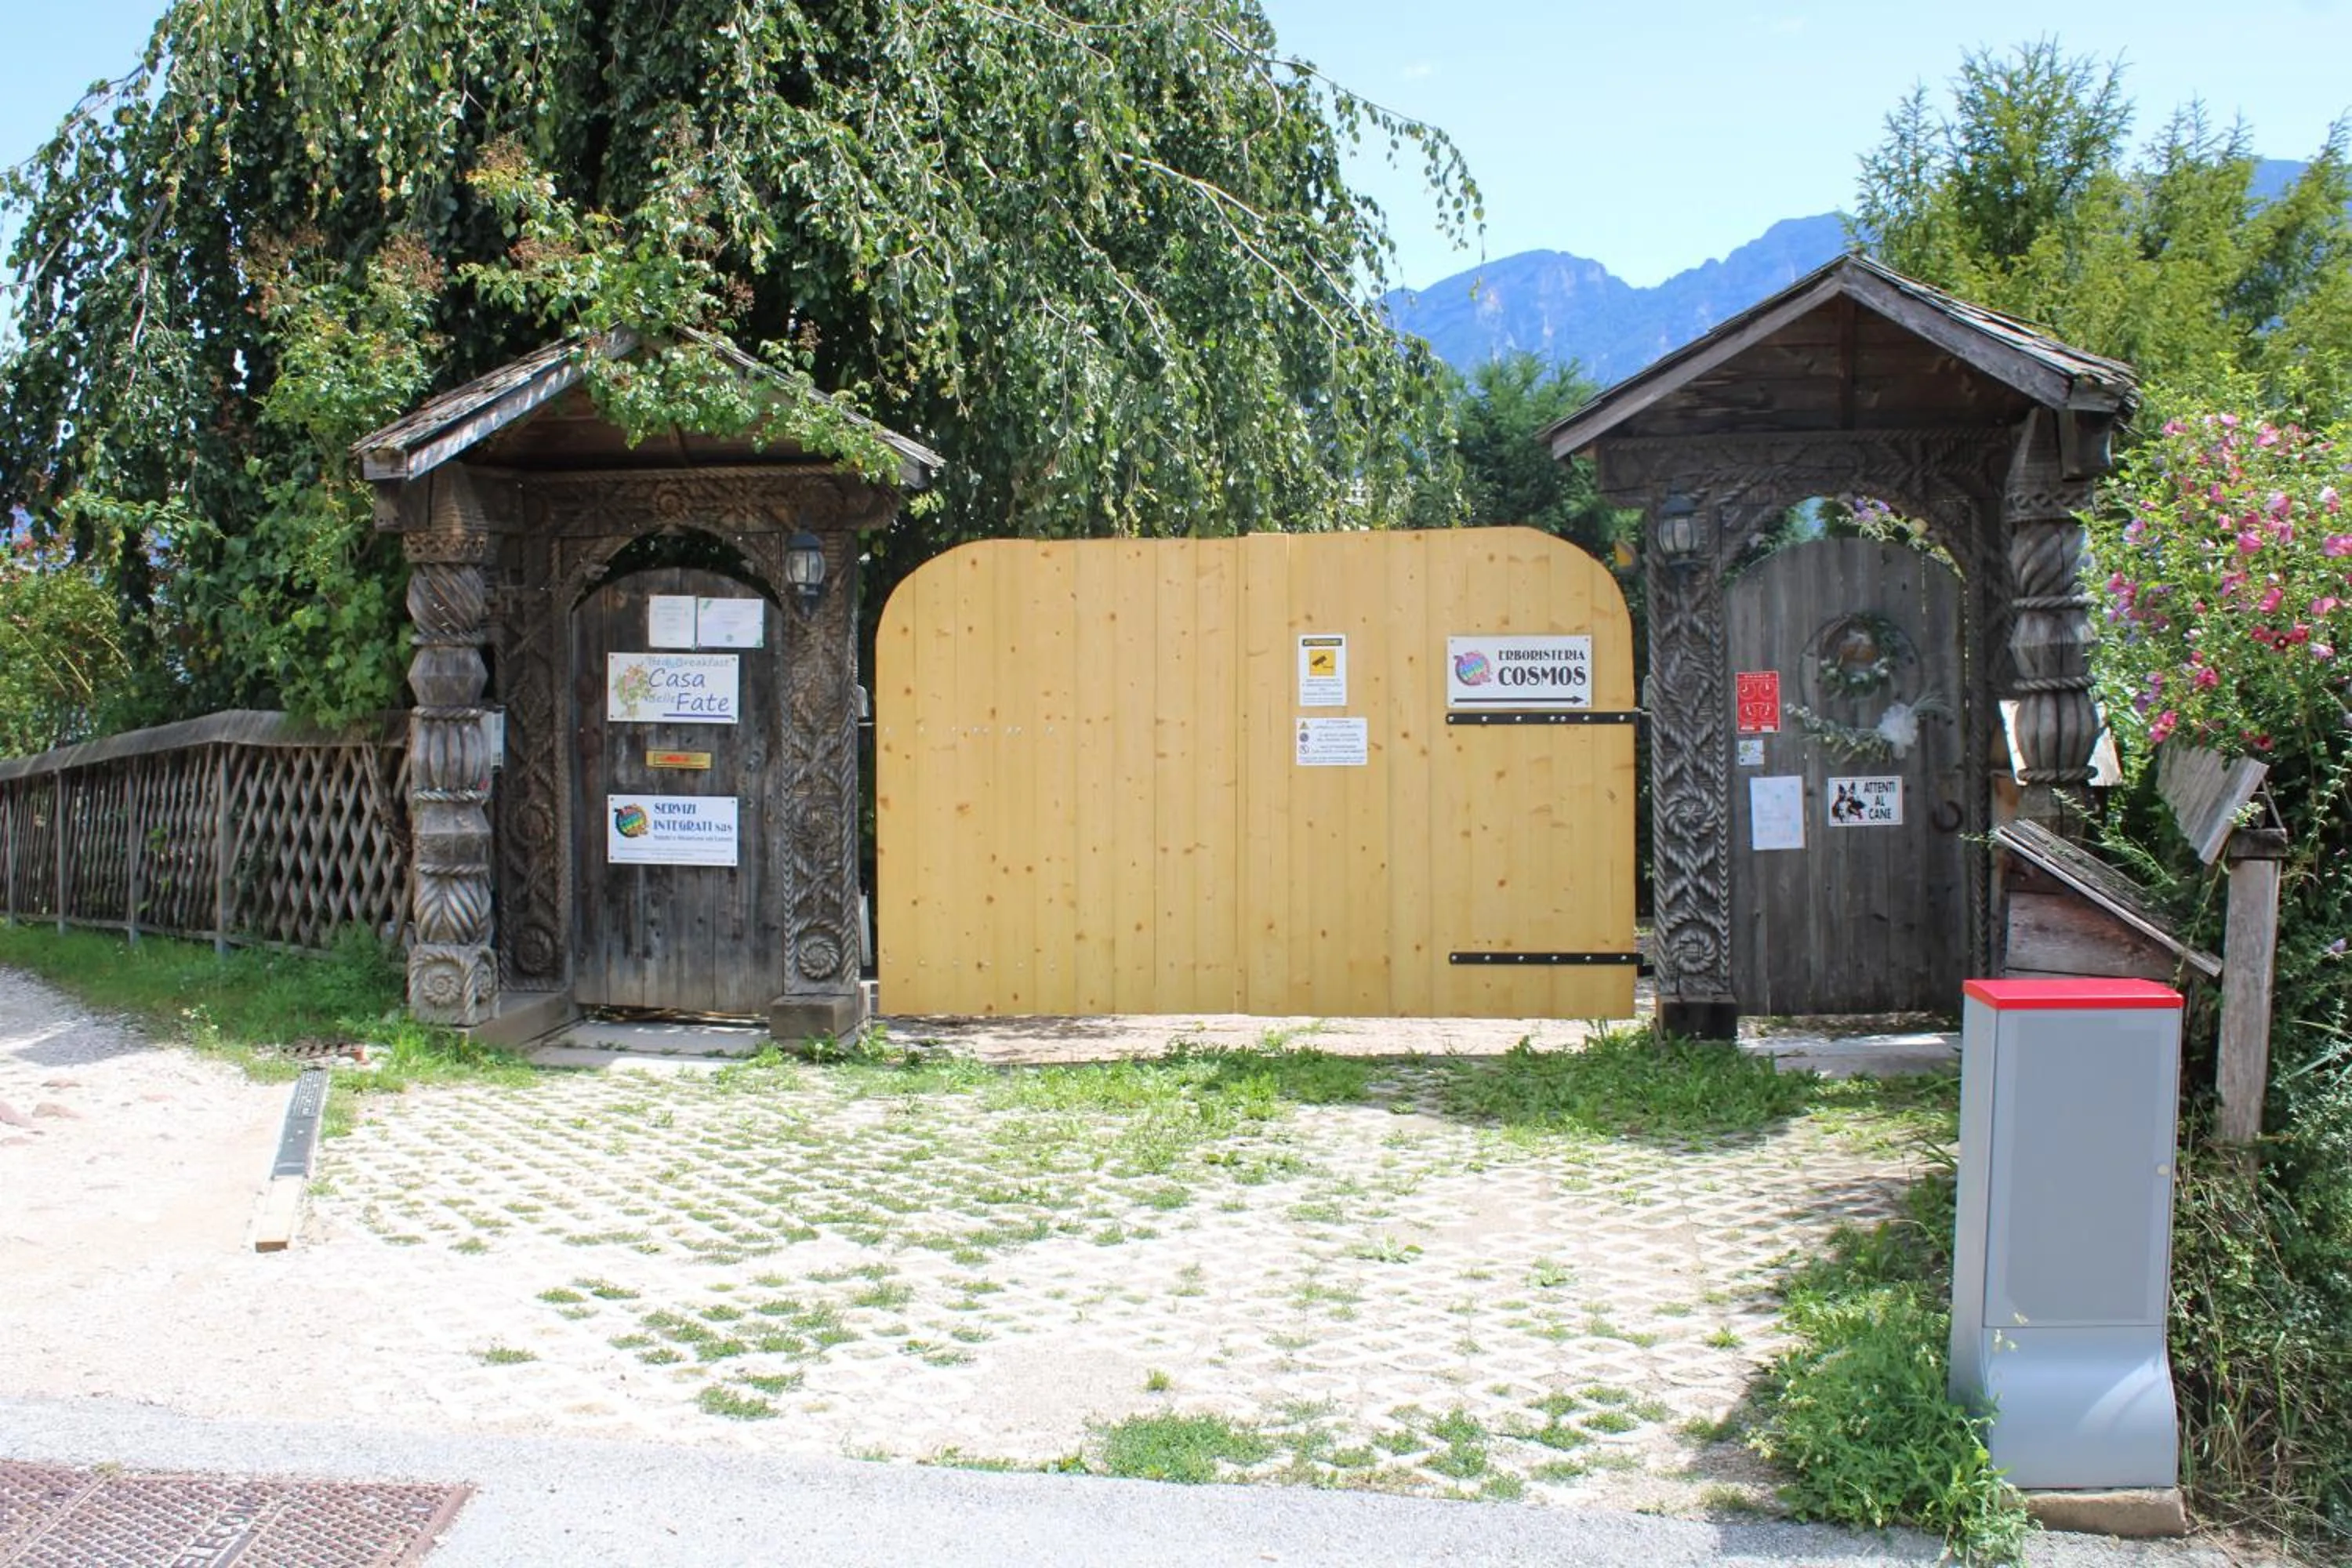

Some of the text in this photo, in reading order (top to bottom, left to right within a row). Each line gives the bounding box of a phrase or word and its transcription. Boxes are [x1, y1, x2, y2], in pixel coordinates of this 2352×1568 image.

[1498, 650, 1585, 661] ERBORISTERIA
[648, 668, 705, 688] Casa
[1498, 666, 1586, 686] COSMOS
[677, 692, 729, 712] Fate
[1863, 781, 1896, 793] ATTENTI
[1875, 795, 1885, 807] AL
[654, 802, 696, 815] SERVIZI
[1868, 808, 1892, 820] CANE
[653, 819, 712, 832] INTEGRATI
